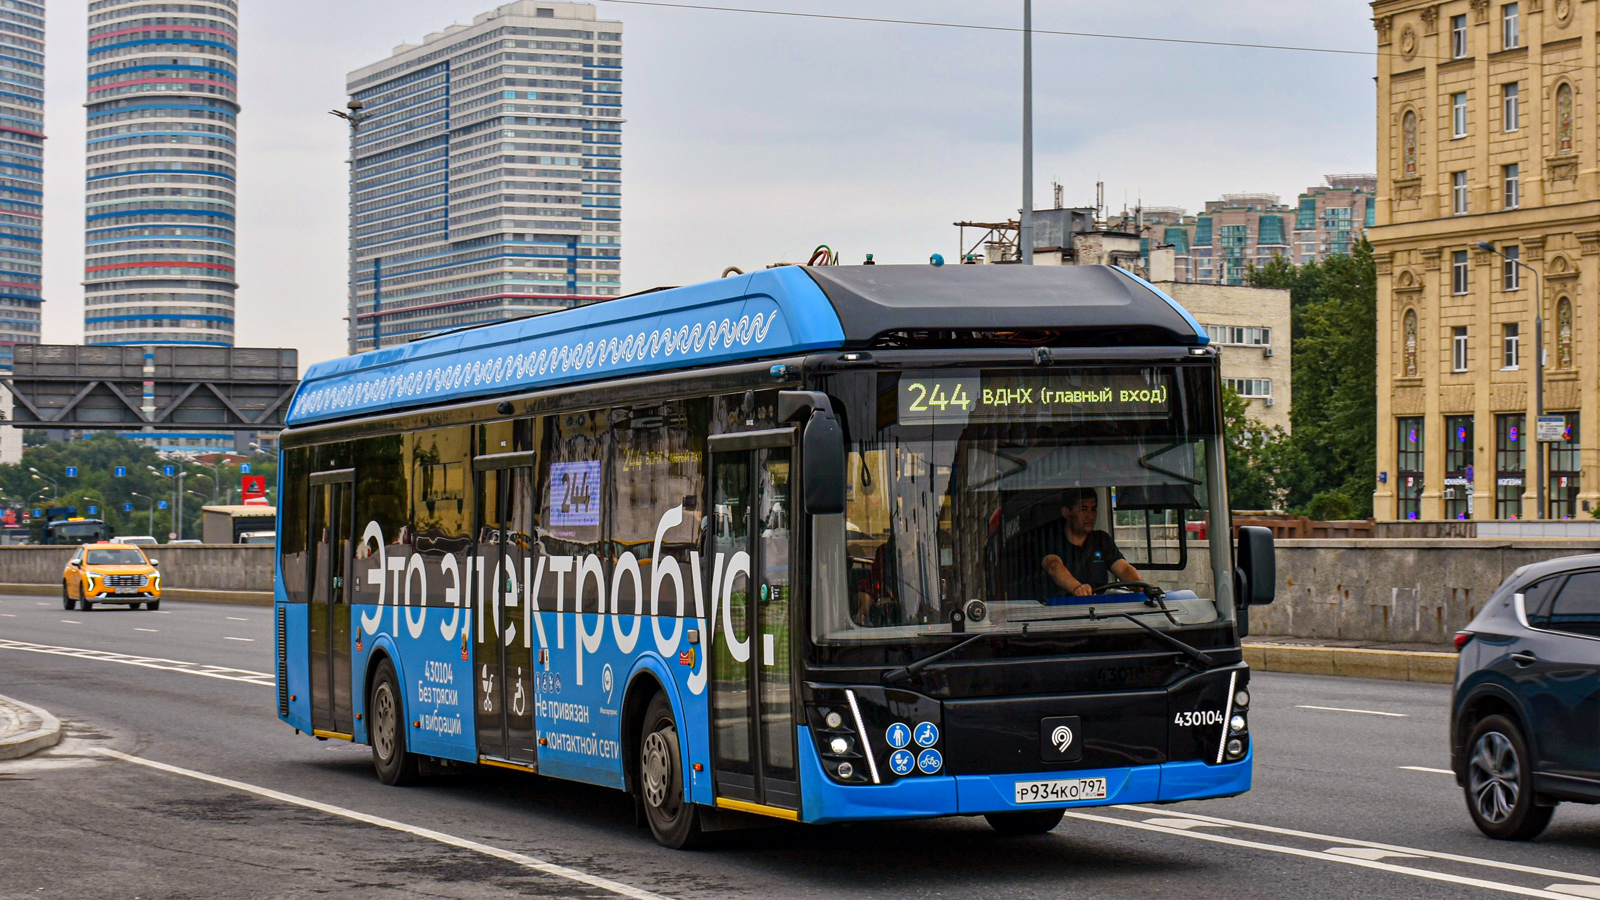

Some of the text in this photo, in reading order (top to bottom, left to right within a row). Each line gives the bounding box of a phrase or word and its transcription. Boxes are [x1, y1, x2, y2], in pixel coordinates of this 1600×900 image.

[907, 383, 1167, 411] 244 ВДНХ (главный вход)
[562, 472, 590, 513] 244
[361, 504, 774, 695] Это электробус.
[425, 660, 453, 684] 430104
[418, 680, 458, 709] Без тряски
[535, 693, 547, 718] Не
[548, 700, 590, 724] привязан
[425, 709, 461, 737] вибраций
[1174, 710, 1223, 727] 430104
[546, 732, 598, 756] контактной
[599, 739, 619, 760] сети
[1080, 779, 1102, 793] 797
